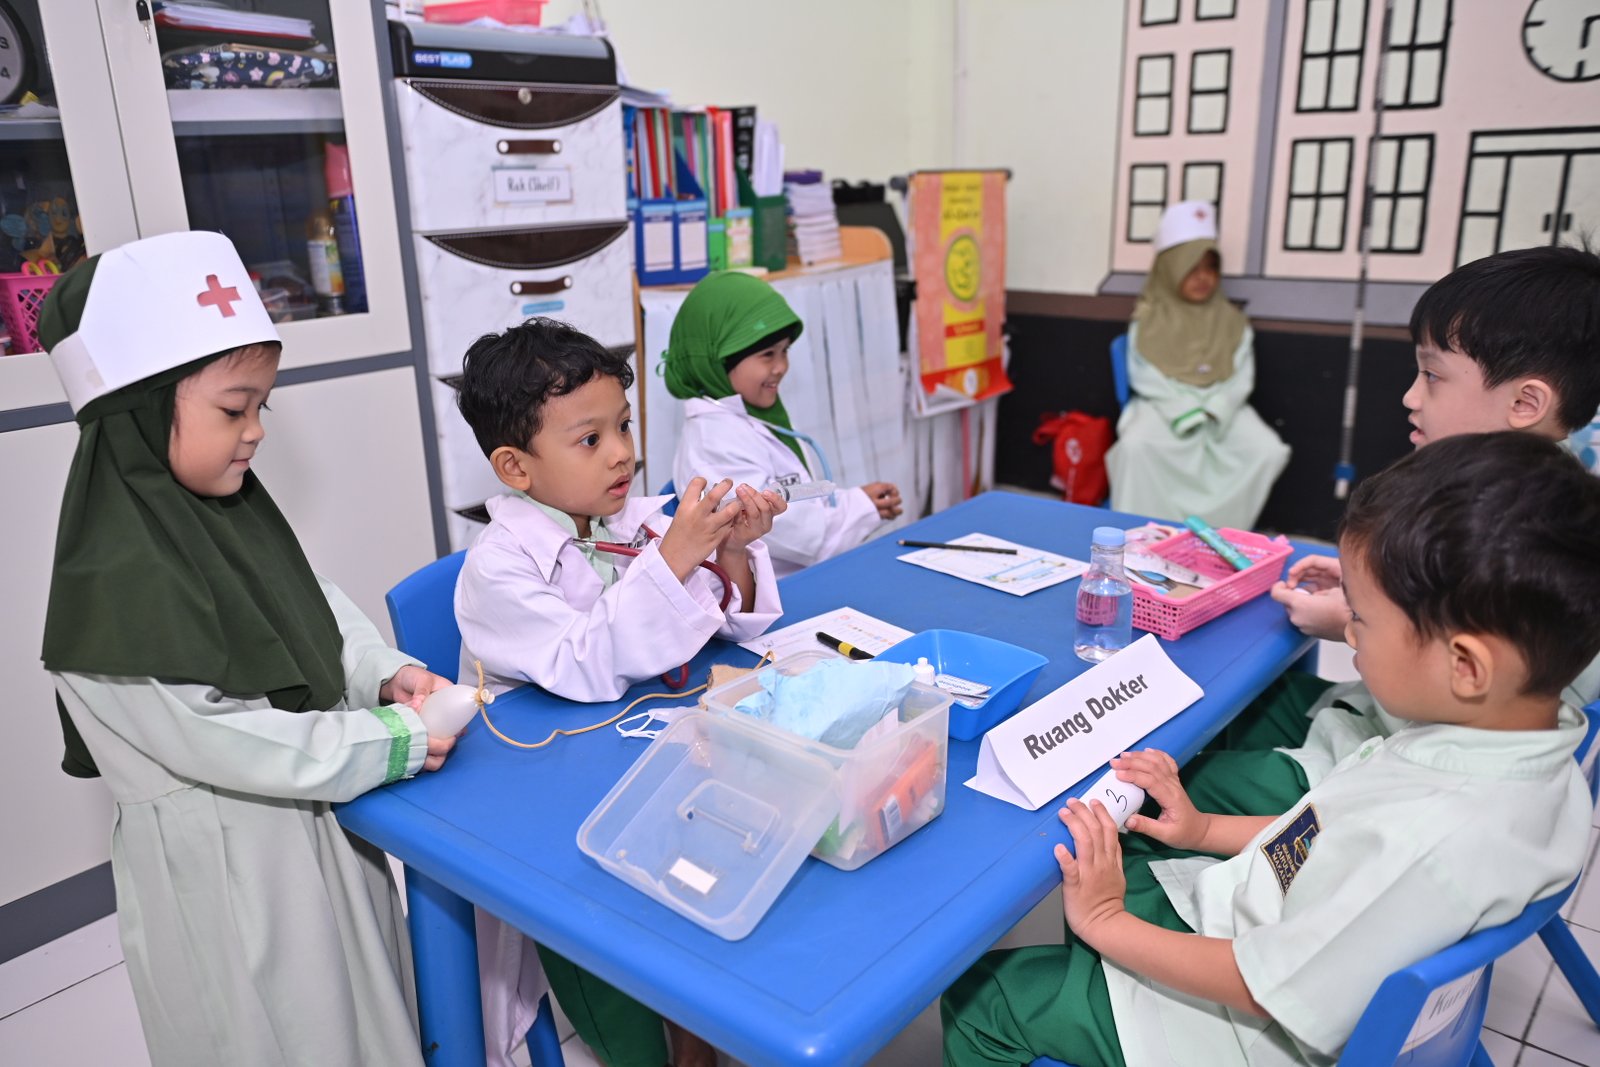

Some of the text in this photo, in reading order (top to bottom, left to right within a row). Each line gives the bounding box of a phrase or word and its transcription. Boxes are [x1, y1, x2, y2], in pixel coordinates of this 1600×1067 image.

[0, 66, 11, 79] 4
[1023, 674, 1148, 760] Ruang Dokter
[1105, 788, 1128, 812] 3
